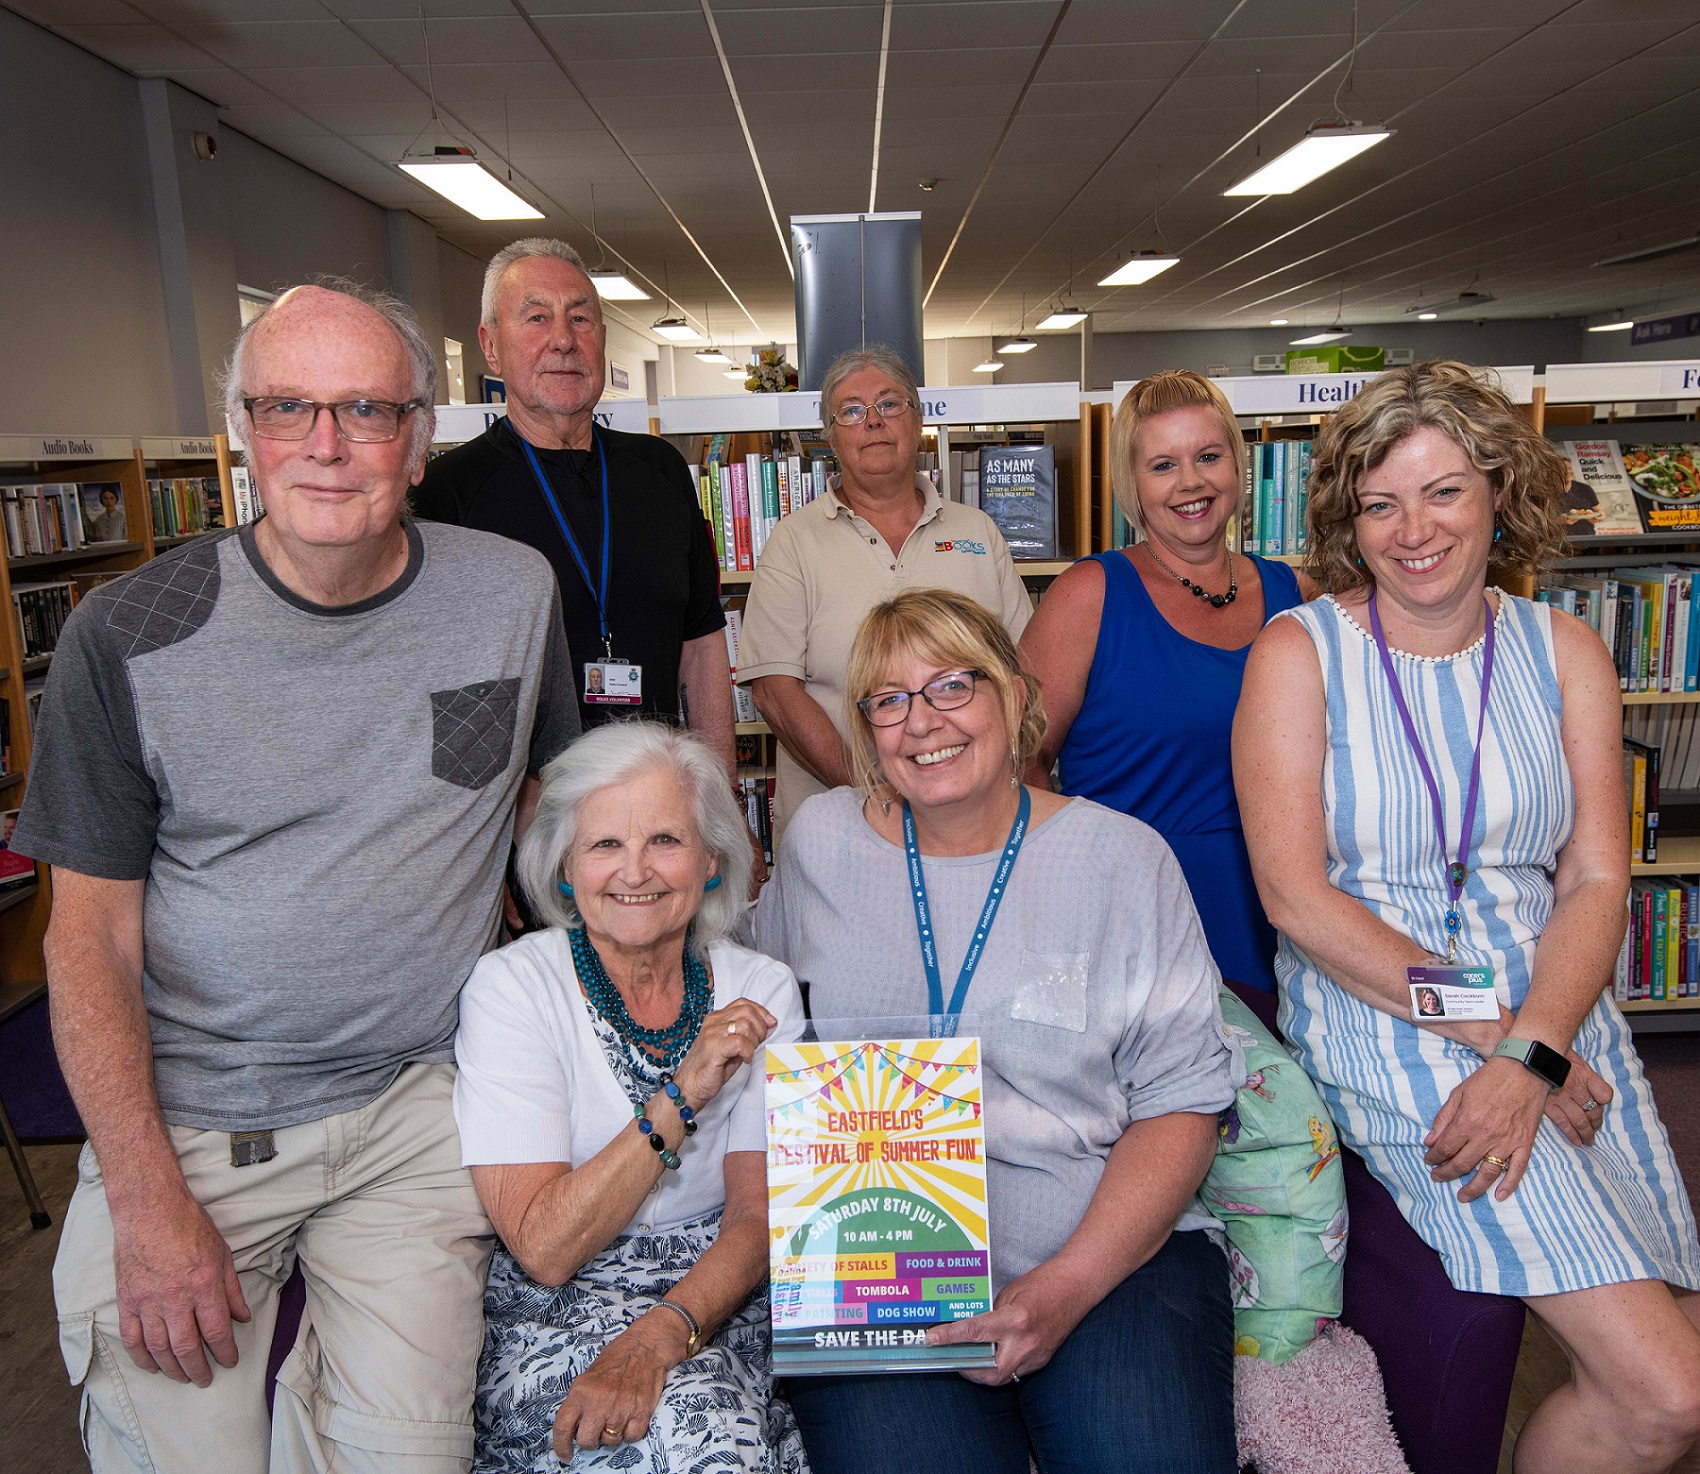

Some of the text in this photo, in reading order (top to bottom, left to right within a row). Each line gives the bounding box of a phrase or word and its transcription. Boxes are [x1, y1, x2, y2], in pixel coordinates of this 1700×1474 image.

[42, 439, 94, 455] Audio Books
[180, 441, 198, 454] Audio
[986, 459, 1035, 473] AS MANY
[986, 474, 1035, 484] AS THE STARS
[1583, 473, 1622, 481] Delicious
[738, 691, 746, 713] SISTERS
[965, 820, 1024, 971] Inclusive Ambitious Creative Together
[911, 858, 920, 887] Ambitious
[918, 902, 927, 925] Creative
[924, 941, 934, 968] Together
[1671, 898, 1680, 917] Pinch
[1656, 893, 1667, 936] Pinch Nom
[1656, 938, 1664, 967] ENJOY
[827, 1109, 923, 1132] EASTFIELD'S
[774, 1139, 976, 1165] FESTIVAL OF SUMMER FUN
[808, 1197, 947, 1240] SATURDAY 8TH JULY
[843, 1231, 857, 1242] 10
[858, 1231, 877, 1242] AM
[886, 1230, 893, 1240] 4
[895, 1230, 913, 1241] PM
[830, 1261, 846, 1272] OF
[847, 1260, 888, 1272] STALLS
[906, 1256, 982, 1269] FOOD & DRINK
[856, 1285, 910, 1296] TOMBOLA
[936, 1283, 976, 1294] GAMES
[877, 1306, 936, 1318] DOG SHOW
[949, 1302, 965, 1310] AND
[805, 1308, 863, 1319] PAINTING
[954, 1311, 974, 1319] MORE
[814, 1329, 930, 1348] SAVE THE DA
